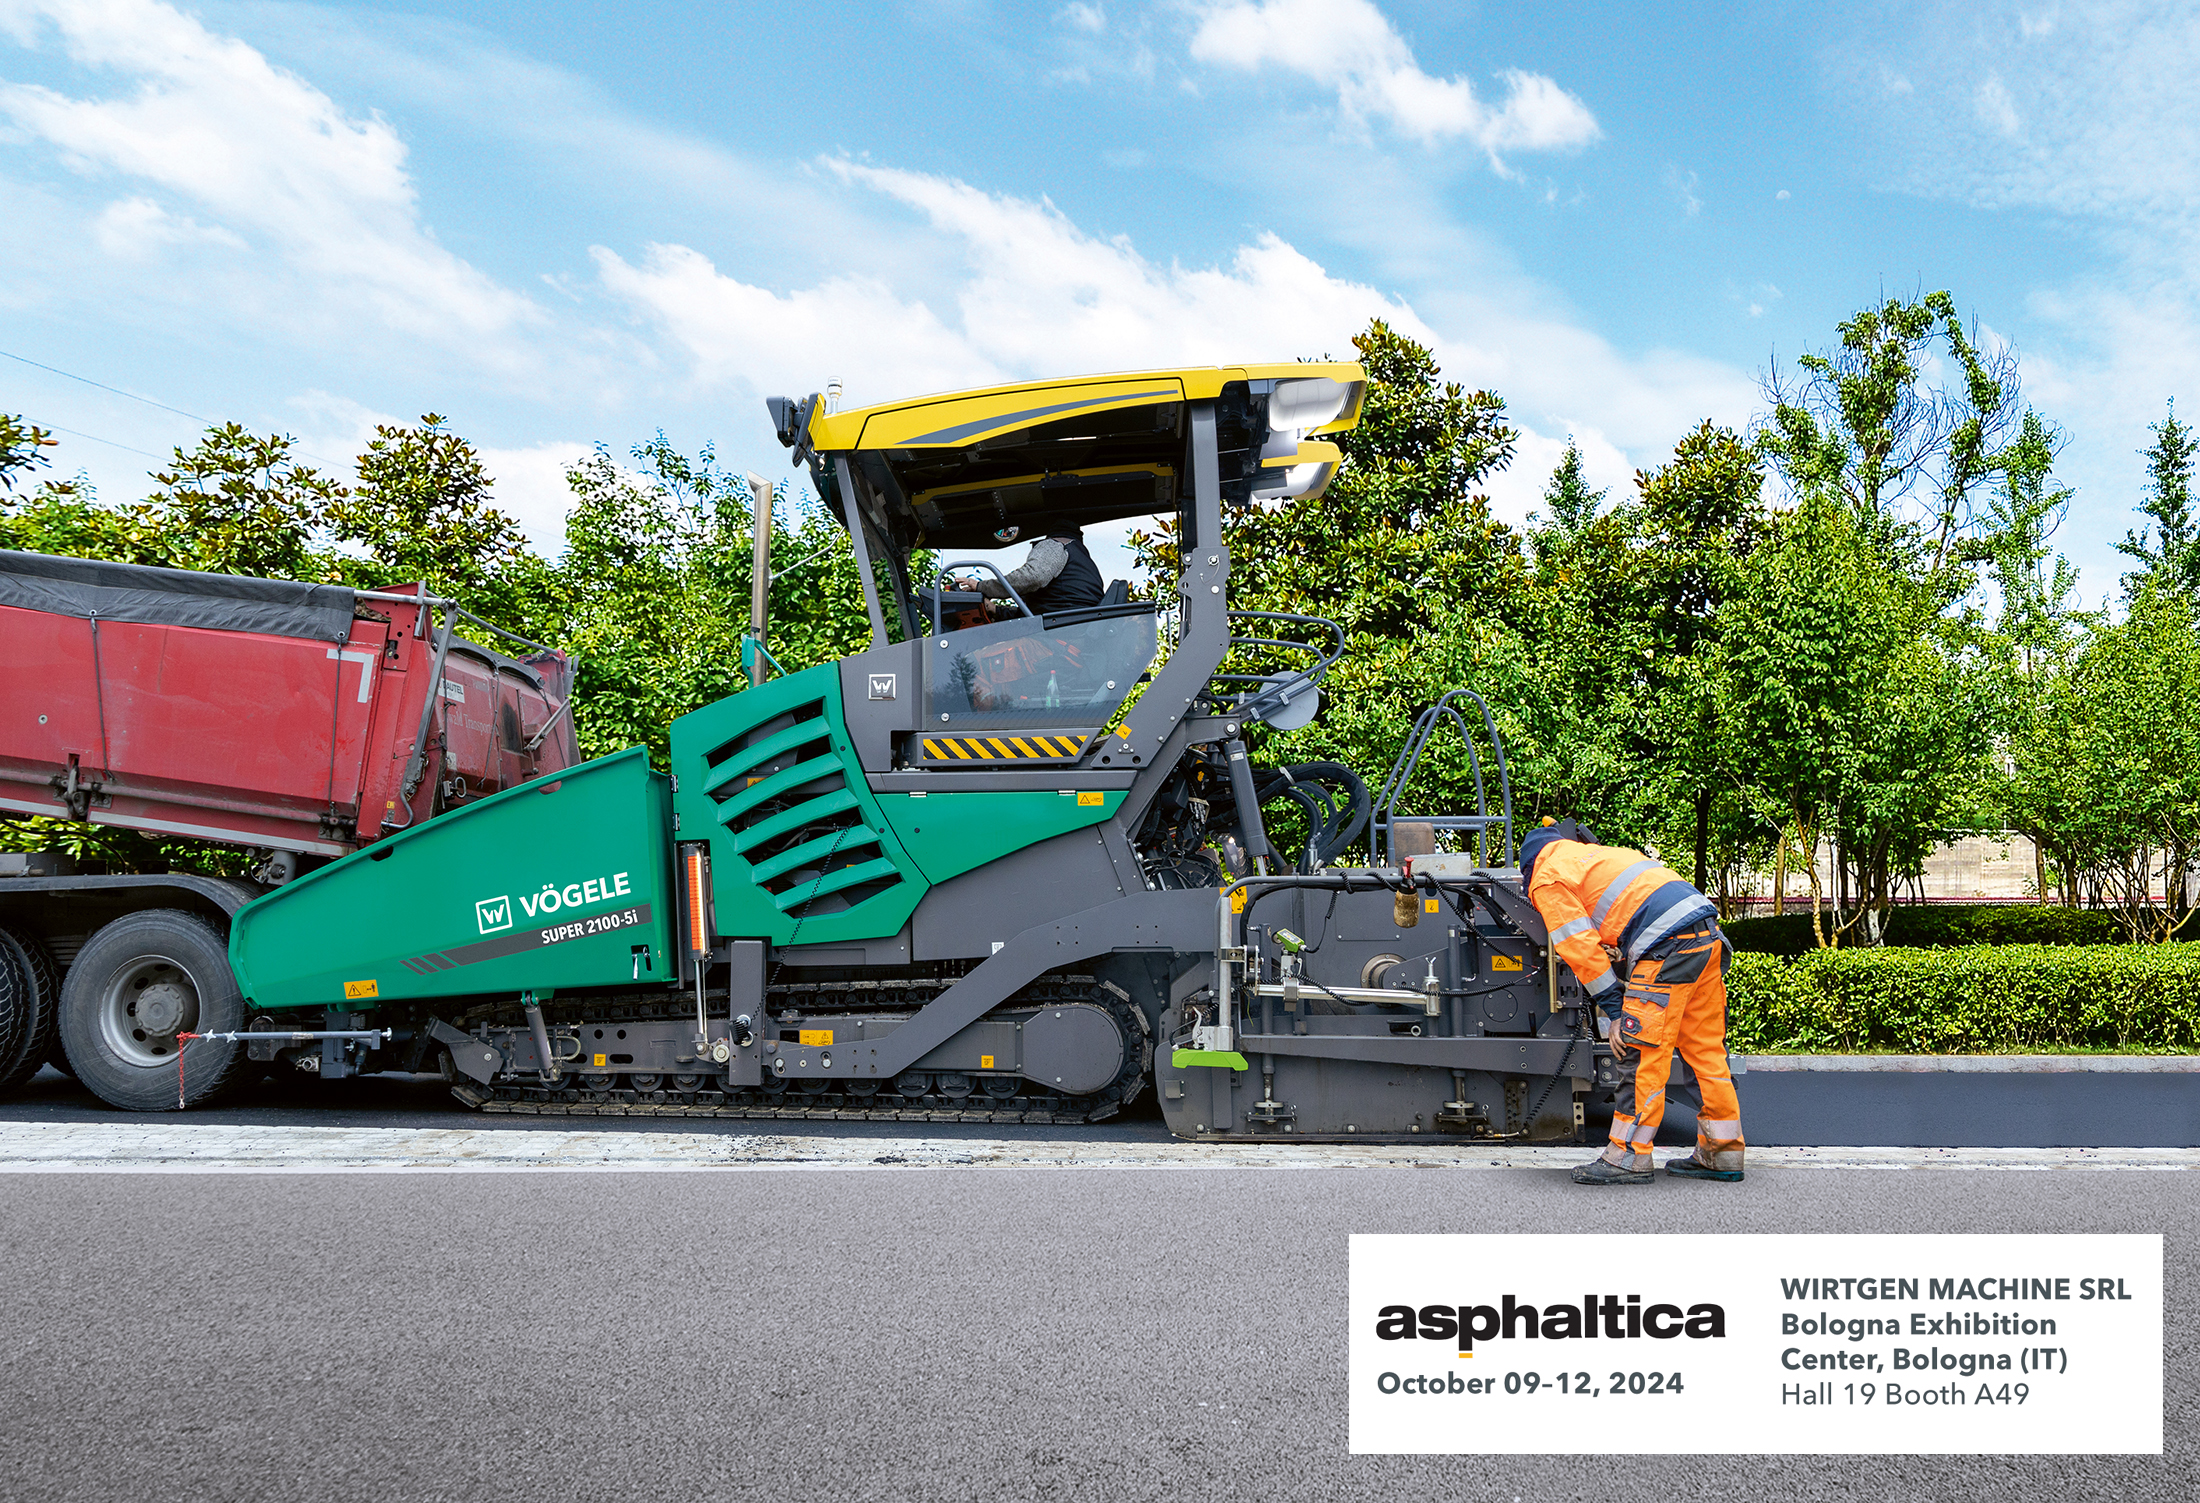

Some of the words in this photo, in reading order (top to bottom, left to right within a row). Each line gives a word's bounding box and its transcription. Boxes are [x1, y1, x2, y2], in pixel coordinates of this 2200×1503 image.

[519, 872, 631, 917] VÖGELE
[541, 922, 585, 945] SUPER
[587, 909, 639, 933] 2100-5i
